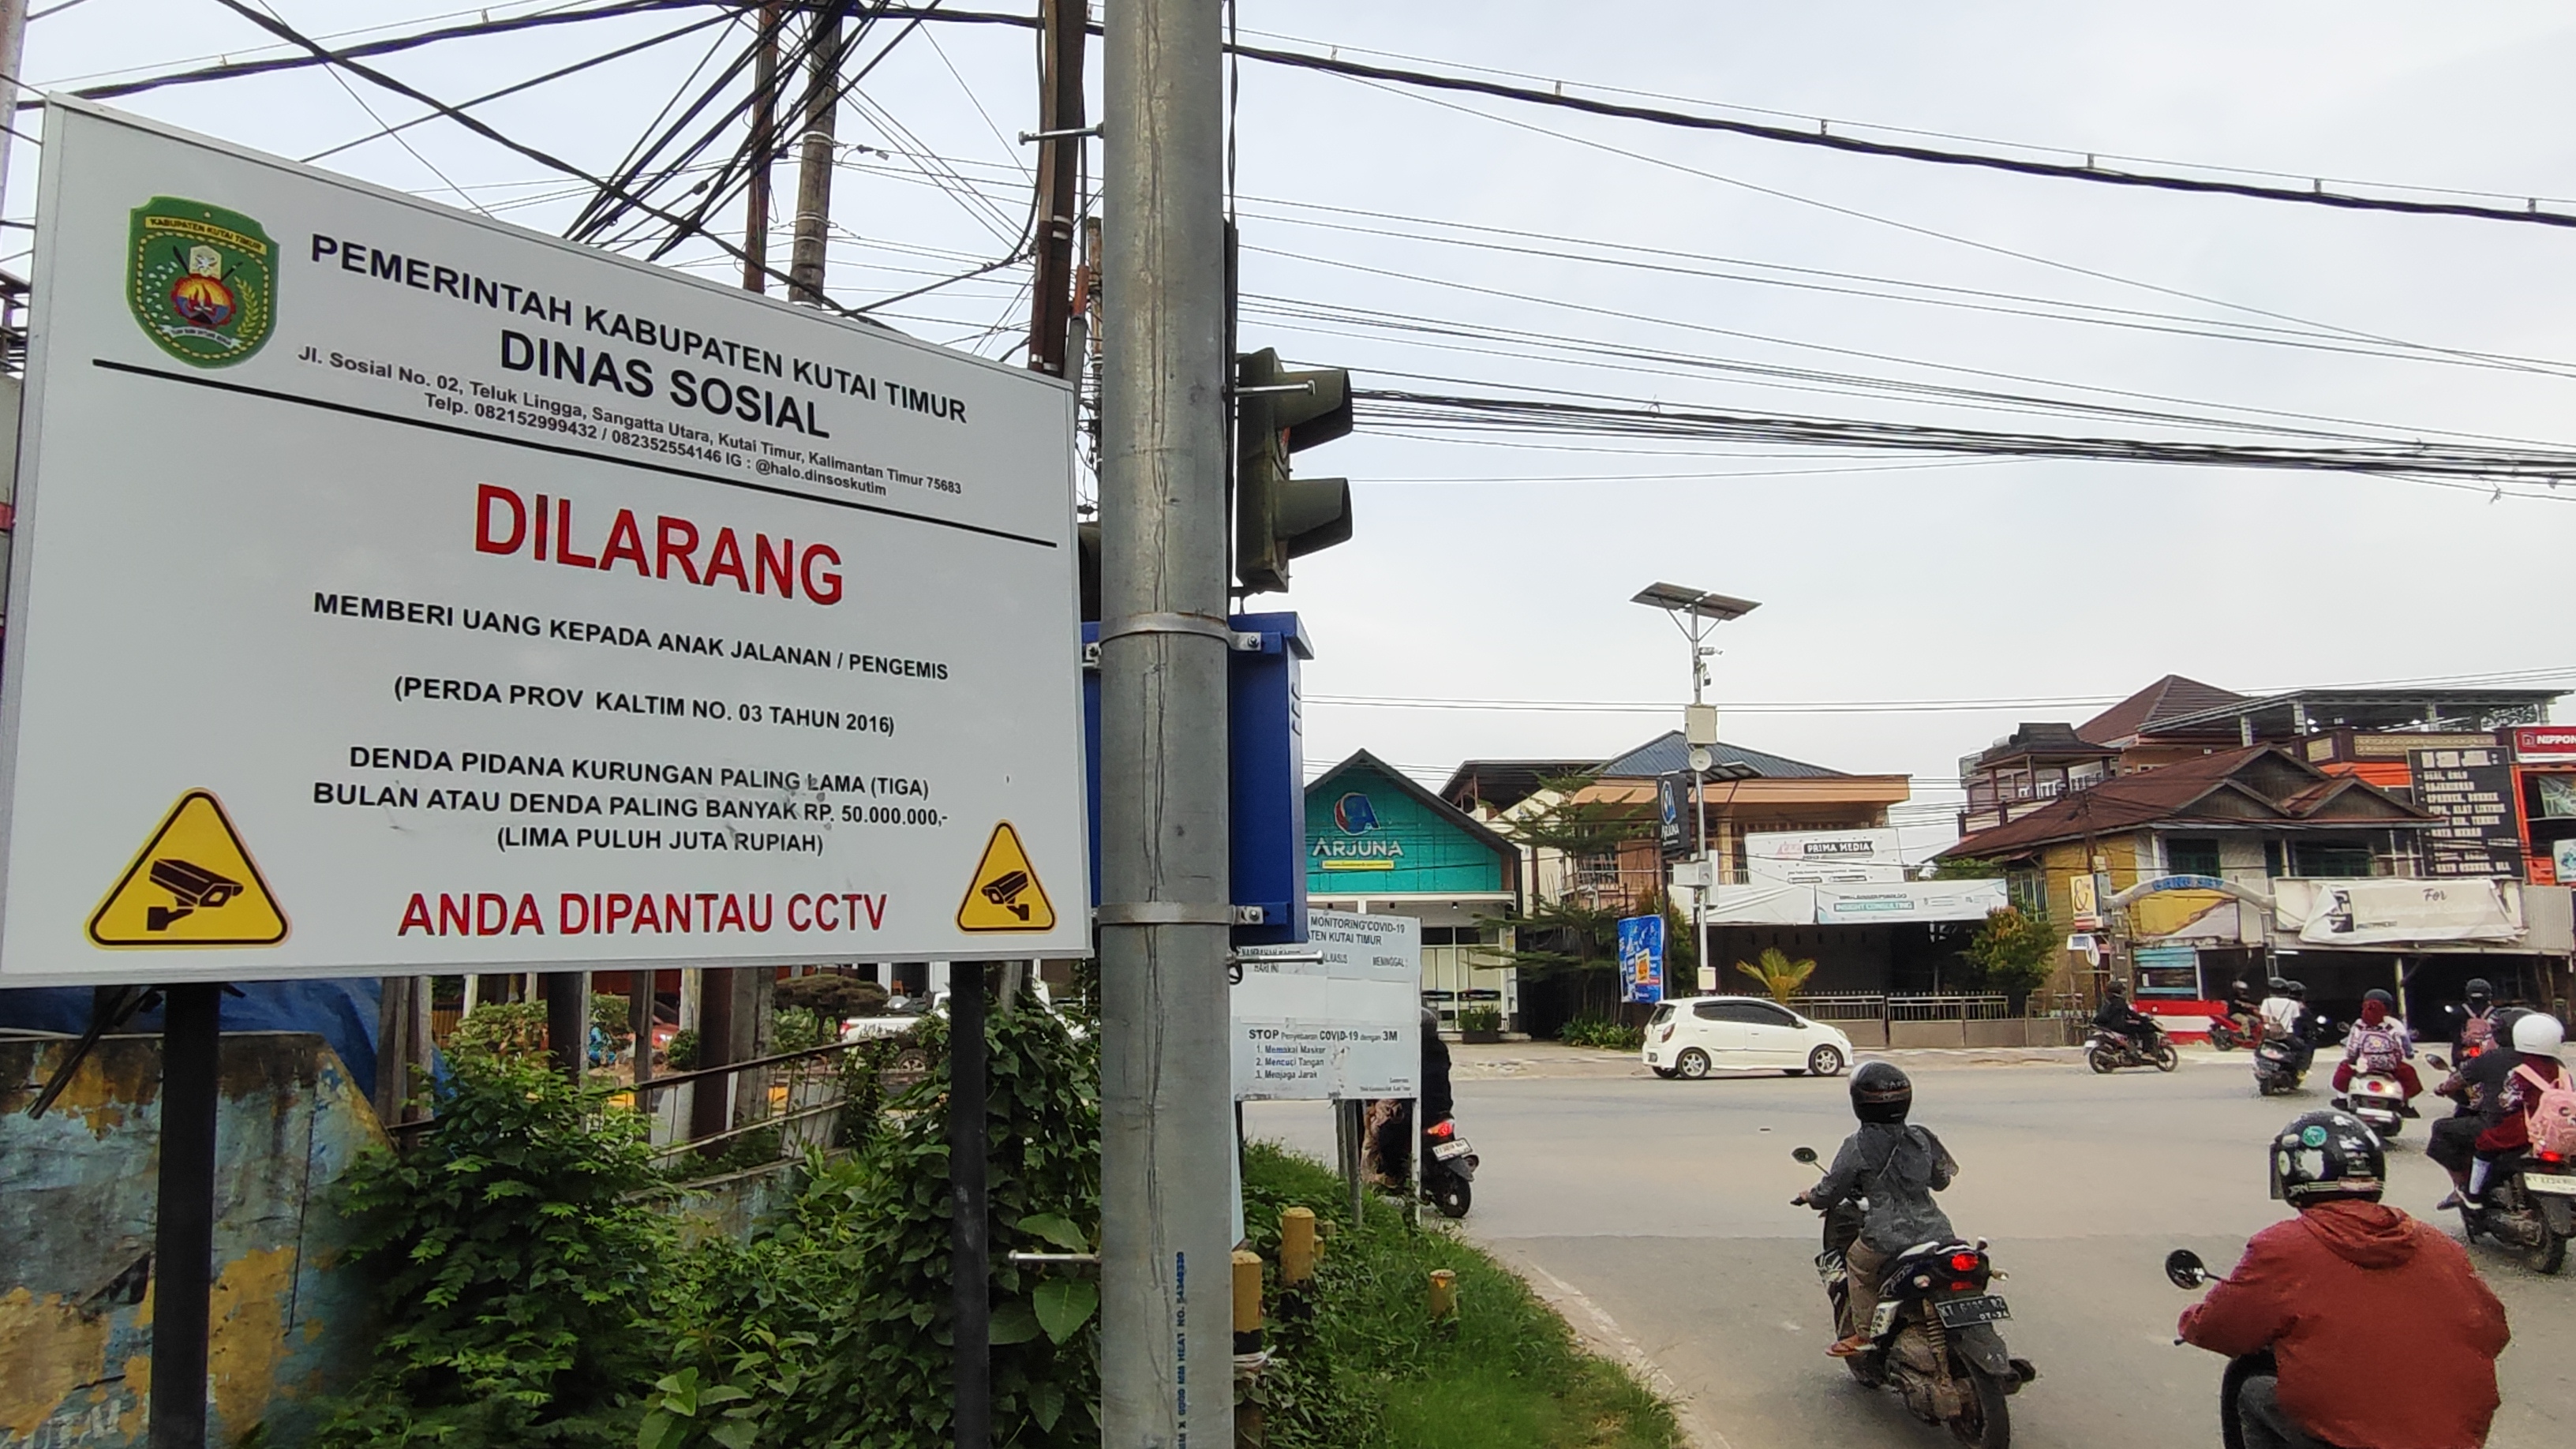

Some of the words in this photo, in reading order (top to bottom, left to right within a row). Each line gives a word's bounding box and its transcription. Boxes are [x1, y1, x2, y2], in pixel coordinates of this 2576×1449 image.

[150, 219, 204, 232] KABUPATEN
[207, 227, 234, 240] KUTAI
[311, 233, 571, 327] PEMERINTAH
[585, 305, 783, 378] KABUPATEN
[793, 358, 876, 401] KUTAI
[884, 381, 967, 424] TIMUR
[501, 328, 654, 399] DINAS
[669, 369, 830, 440] SOSIAL
[298, 346, 323, 365] Jl.
[329, 352, 392, 379] Sosial
[399, 366, 431, 387] No.
[436, 375, 463, 395] 02,
[469, 380, 518, 404] Teluk
[523, 391, 587, 421] Lingga,
[592, 406, 664, 434] Sangatta
[668, 421, 713, 446] Utara,
[718, 432, 757, 452] Kutai
[760, 440, 805, 464] Timur,
[808, 451, 884, 478] Kalimantan
[886, 467, 924, 486] Timur
[926, 476, 962, 495] 75683
[424, 392, 469, 416] Telp.
[474, 402, 597, 440] 082152999432
[611, 429, 722, 463] 082352554146
[725, 451, 742, 467] IG
[755, 459, 886, 496] @halo.dinsoskutim
[475, 483, 843, 606] DILARANG
[313, 592, 453, 627] MEMBERI
[462, 608, 541, 637] UANG
[549, 619, 653, 648] KEPADA
[657, 632, 724, 657] ANAK
[730, 640, 831, 668] JALANAN
[849, 653, 949, 680] PENGEMIS
[394, 676, 503, 704] (PERDA
[509, 684, 584, 709] PROV
[596, 691, 685, 717] KALTIM
[692, 699, 732, 721] NO.
[738, 703, 762, 723] 03
[768, 706, 840, 729] TAHUN
[846, 713, 895, 738] 2016)
[350, 746, 454, 772] DENDA
[462, 752, 565, 777] PIDANA
[572, 758, 713, 786] KURUNGAN
[720, 767, 801, 792] PALING
[807, 773, 866, 794] LAMA
[871, 777, 929, 801] (TIGA)
[313, 781, 418, 808] BULAN
[425, 788, 500, 812] ATAU
[510, 792, 603, 815] DENDA
[609, 796, 698, 818] PALING
[706, 797, 798, 820] BANYAK
[804, 803, 835, 822] RP.
[841, 804, 948, 827] 50.000.000,-
[497, 826, 570, 853] (LIMA
[576, 828, 661, 850] PULUH
[668, 830, 728, 852] JUTA
[732, 831, 824, 857] RUPIAH)
[1312, 837, 1403, 856] ARJUNA
[1807, 843, 1837, 852] PRIMA
[1839, 842, 1870, 852] MEDIA
[397, 893, 545, 937] ANDA
[560, 893, 773, 935] DIPANTAU
[787, 893, 888, 932] CCTV
[2423, 888, 2447, 900] For
[1310, 916, 1366, 930] MONITORING
[1368, 921, 1405, 934] COVID-19
[1329, 932, 1354, 943] KUTAI
[1357, 934, 1382, 945] TIMUR
[1249, 1029, 1279, 1039] STOP
[1320, 1031, 1358, 1041] COVID-19
[1382, 1031, 1398, 1041] 3M
